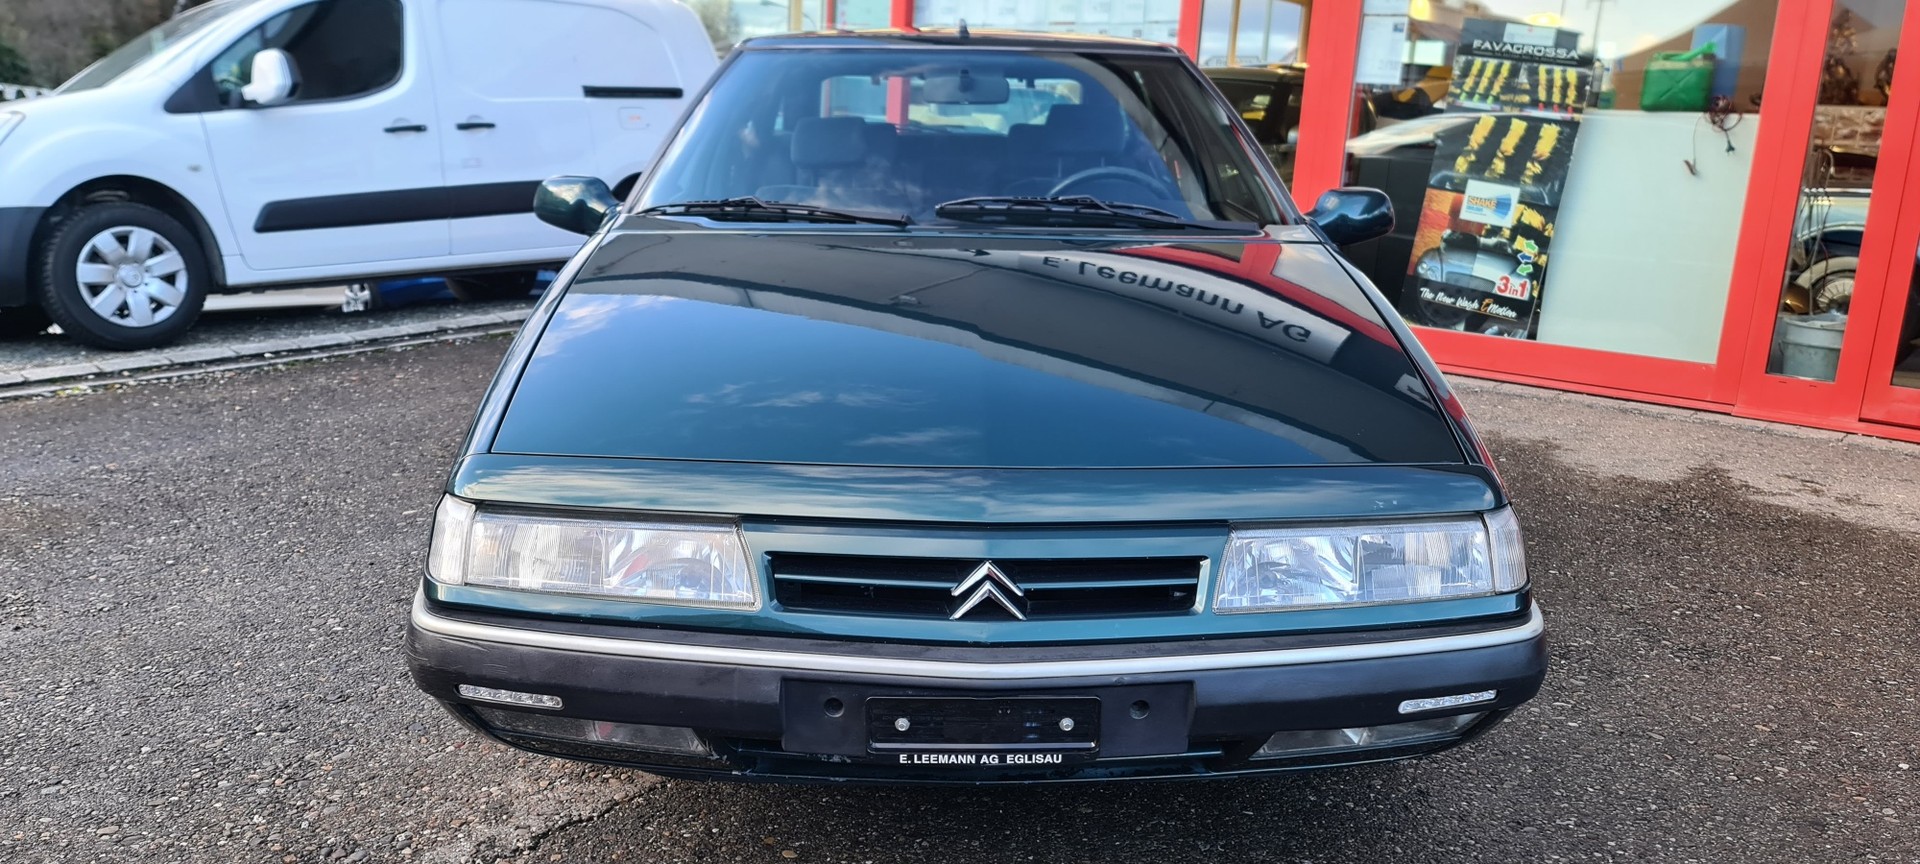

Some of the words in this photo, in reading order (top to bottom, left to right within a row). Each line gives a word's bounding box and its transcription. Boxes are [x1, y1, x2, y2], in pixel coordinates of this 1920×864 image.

[1473, 39, 1579, 60] FAVAGROSSA
[1420, 287, 1435, 299] The
[1456, 296, 1479, 311] Wash
[900, 754, 911, 764] E.
[914, 754, 976, 764] LEEMANN
[980, 754, 999, 764] AG
[1007, 754, 1062, 764] EGLISAU
